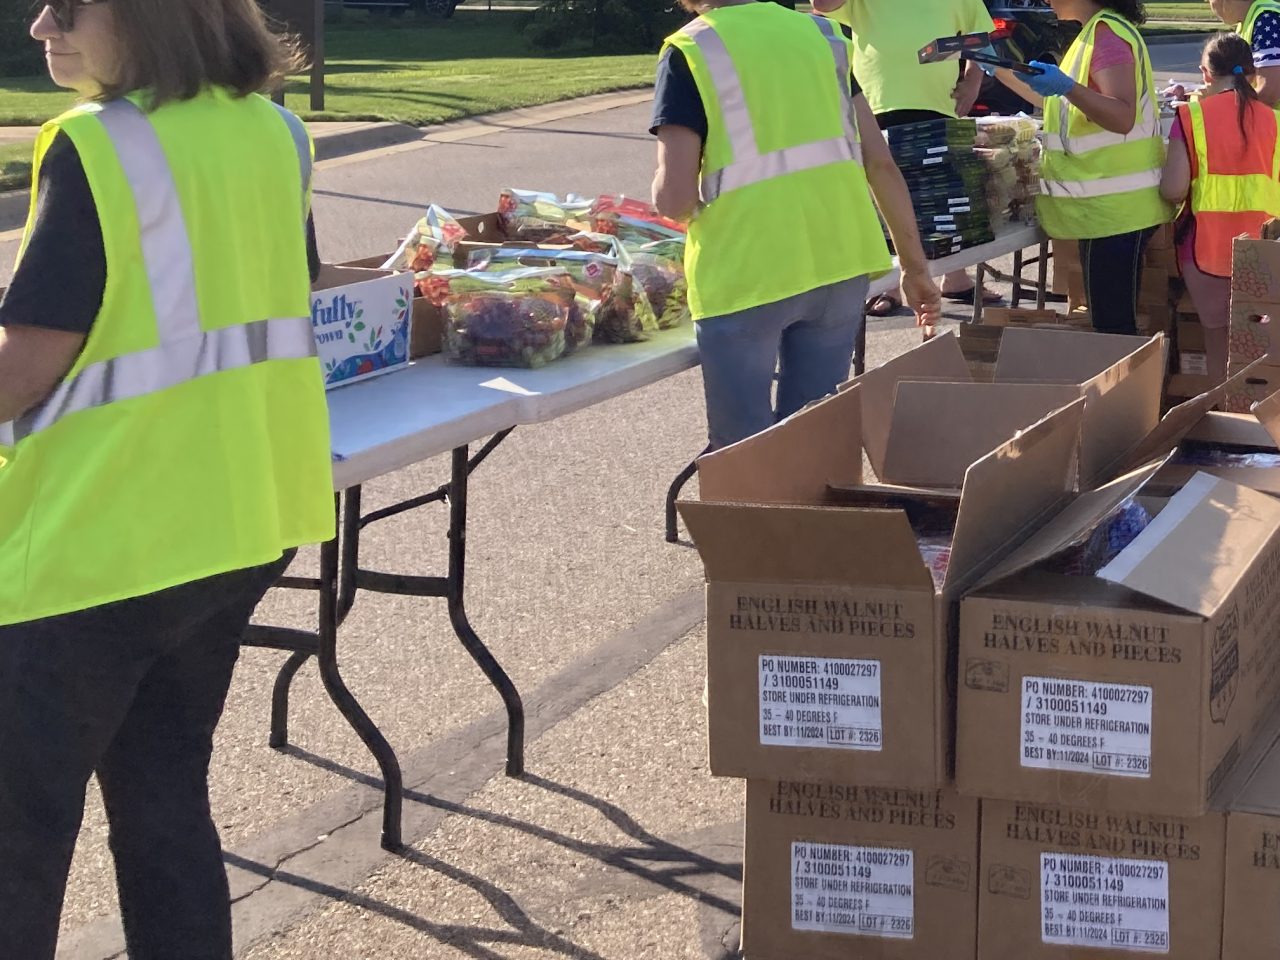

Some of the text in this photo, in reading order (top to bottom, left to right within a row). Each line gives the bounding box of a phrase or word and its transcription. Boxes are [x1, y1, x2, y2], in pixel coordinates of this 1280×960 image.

[312, 294, 357, 329] fully
[737, 597, 904, 619] ENGLISH WALNUT
[730, 614, 916, 638] HALVES AND PIECES
[992, 615, 1169, 643] ENGLISH WALNUT
[984, 631, 1182, 663] HALVES AND PIECES
[762, 660, 877, 676] PO NUMBER: 4100027297
[772, 674, 838, 690] 3100051149
[763, 690, 878, 707] STORE UNDER REFRIGERATION
[1026, 681, 1148, 704] PO NUMBER: 4100027297
[763, 708, 771, 719] 35
[785, 709, 793, 721] 40
[796, 710, 830, 723] DEGREES
[1035, 696, 1106, 715] 3100051149
[1025, 711, 1149, 734] STORE UNDER REFRIGERATION
[764, 724, 780, 736] BEST
[830, 729, 844, 740] LOT
[858, 730, 879, 742] 2326
[1025, 729, 1034, 741] 35
[1048, 732, 1057, 744] 40
[1060, 733, 1097, 748] DEGREES
[1025, 745, 1042, 759] BEST
[1096, 753, 1110, 766] LOT
[1126, 756, 1148, 769] 2326
[777, 781, 944, 809] ENGLISH WALNUT
[769, 797, 956, 829] HALVES AND PIECES
[1015, 806, 1188, 840] ENGLISH WALNUT
[1007, 822, 1200, 860] HALVES AND PIECES
[795, 846, 806, 858] PO
[810, 847, 852, 861] NUMBER:
[1044, 859, 1164, 879] PO NUMBER: 4100027297
[795, 876, 911, 896] STORE UNDER REFRIGERATION
[1054, 873, 1123, 891] 3100051149
[828, 896, 862, 910] DEGREES
[1045, 889, 1165, 910] STORE UNDER REFRIGERATION
[795, 909, 811, 921] BEST
[862, 915, 876, 927] LOT
[1079, 910, 1115, 924] DEGREES
[1045, 924, 1062, 937] BEST
[1115, 930, 1129, 942] LOT
